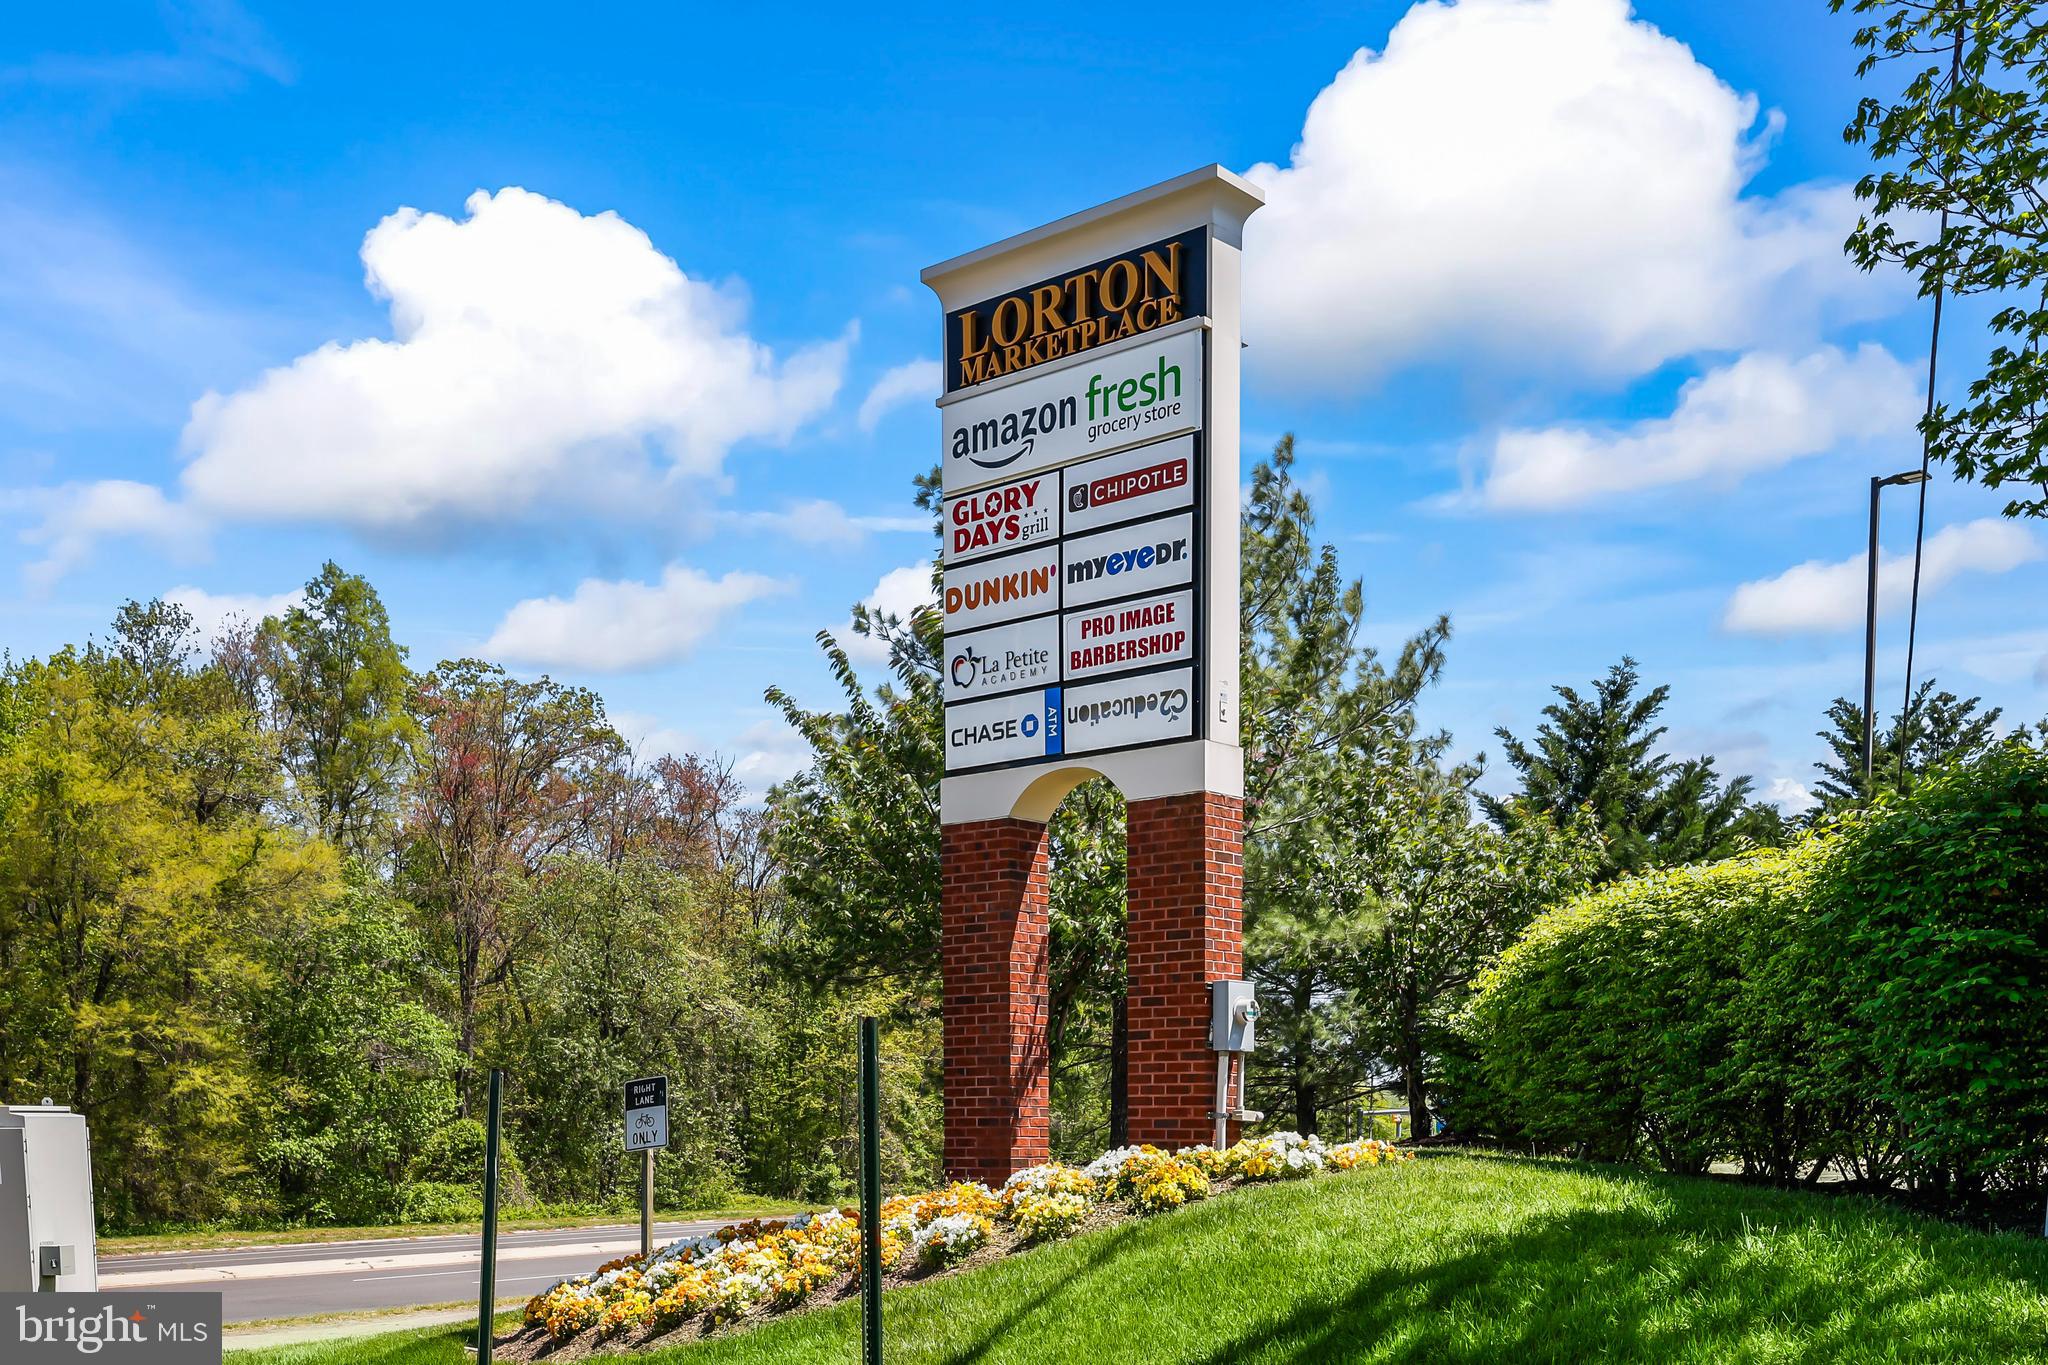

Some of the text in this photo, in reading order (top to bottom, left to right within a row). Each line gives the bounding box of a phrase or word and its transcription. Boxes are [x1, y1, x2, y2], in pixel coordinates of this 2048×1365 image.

[958, 242, 1184, 361] LORTON
[959, 294, 1182, 388] MARKETPLACE
[952, 356, 1181, 460] amazon fresh
[1088, 402, 1181, 443] grocery store
[1094, 464, 1185, 501] CHIPOTLE
[952, 480, 1041, 526] GLORY
[954, 514, 1020, 554] DAYS
[1022, 517, 1049, 541] grill
[945, 564, 1057, 614] DUNKIN'
[1081, 602, 1175, 640] PRO IMAGE
[981, 649, 1049, 674] La Petite
[1070, 630, 1186, 671] BARBERSHOP
[981, 665, 1048, 686] ACADEMY
[951, 719, 1018, 748] CHASE
[1047, 706, 1058, 737] ATM
[633, 1083, 656, 1095] RIGHT
[635, 1095, 655, 1106] LANE
[632, 1129, 658, 1145] ONLY
